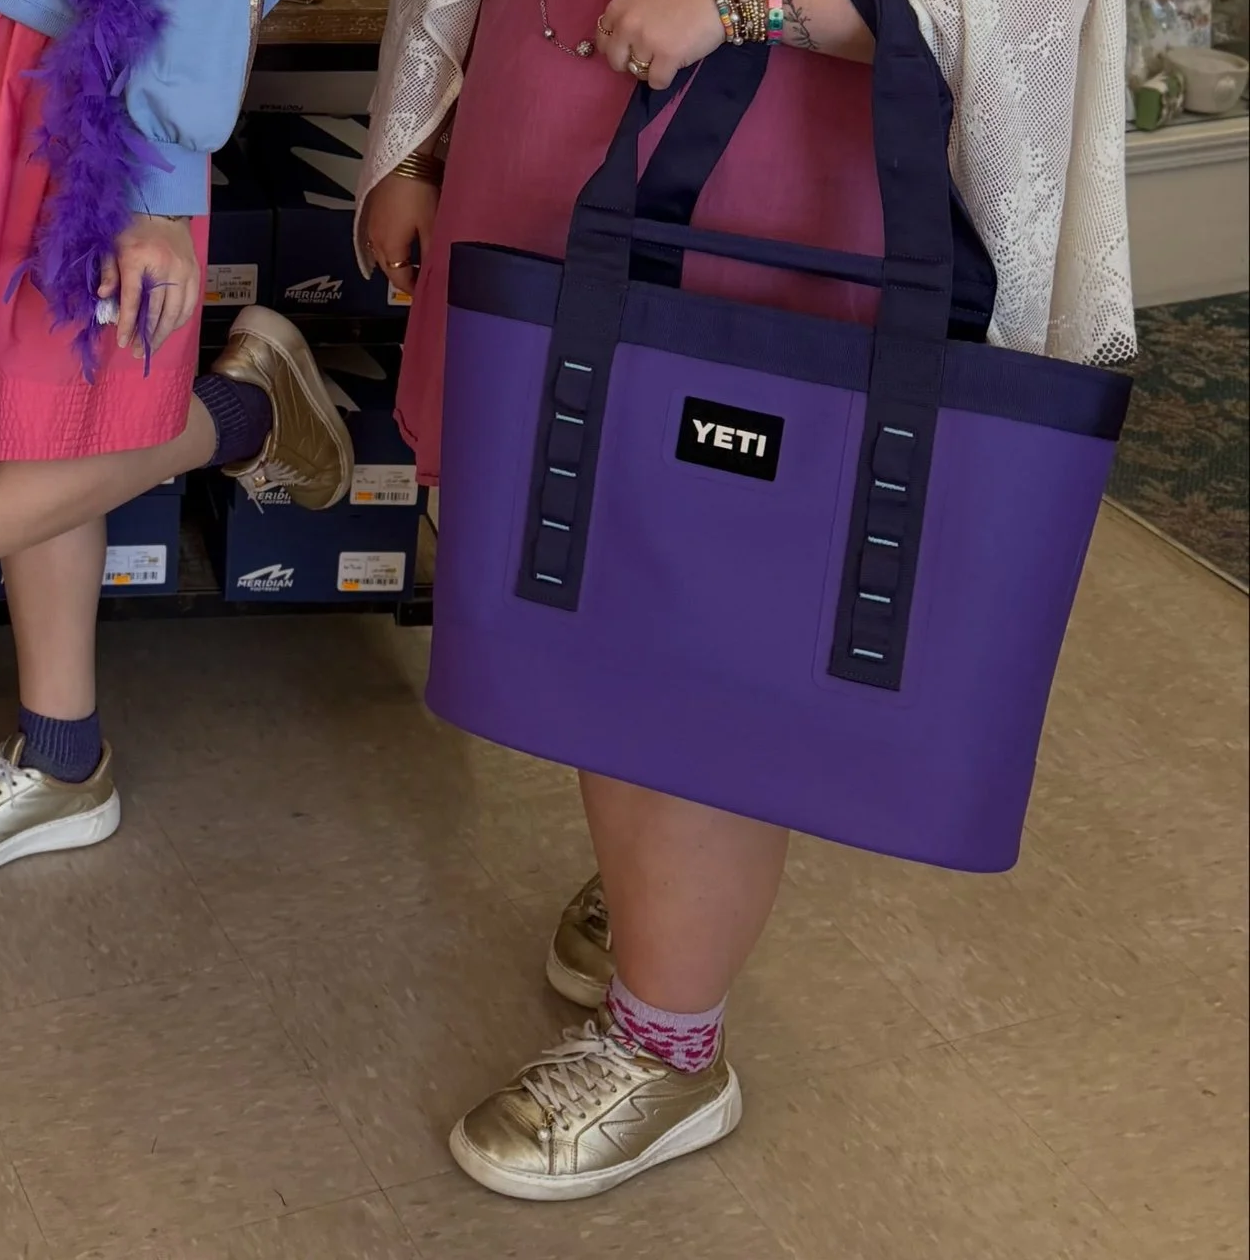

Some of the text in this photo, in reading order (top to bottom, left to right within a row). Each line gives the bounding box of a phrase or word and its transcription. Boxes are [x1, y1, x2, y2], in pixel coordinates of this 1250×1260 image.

[284, 290, 343, 300] MERIDIAN
[692, 418, 768, 458] YETI
[236, 579, 294, 588] MERIDIAN
